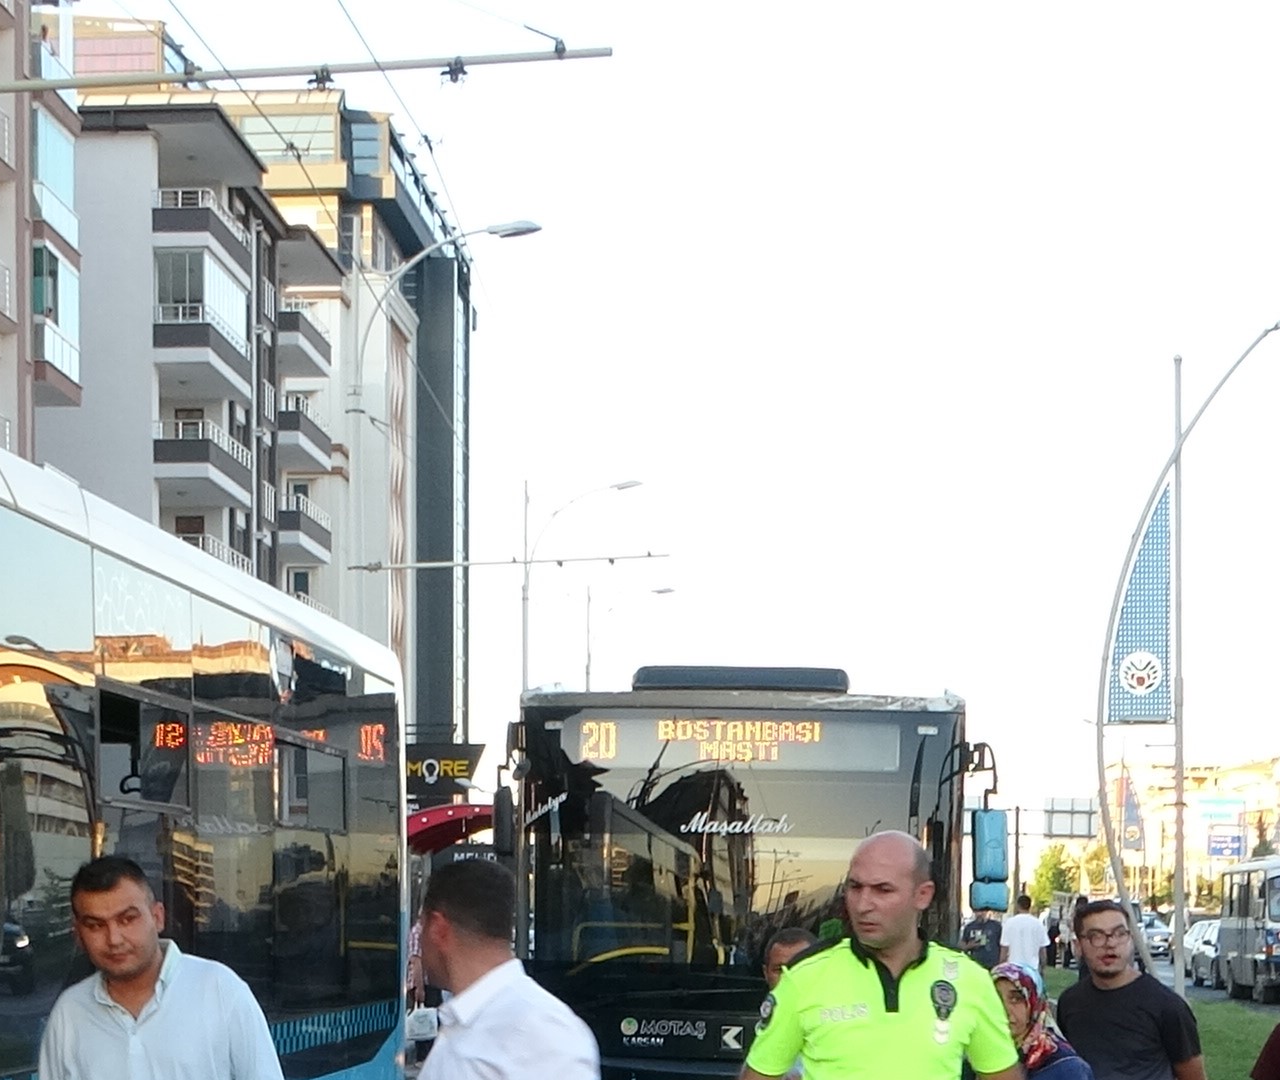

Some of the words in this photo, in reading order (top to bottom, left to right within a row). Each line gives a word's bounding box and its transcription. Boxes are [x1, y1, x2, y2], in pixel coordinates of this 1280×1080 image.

[582, 721, 617, 760] 20
[658, 720, 821, 744] BOSTANBAŞI
[679, 811, 795, 838] Maşallah
[640, 1019, 707, 1041] MOTAŞ
